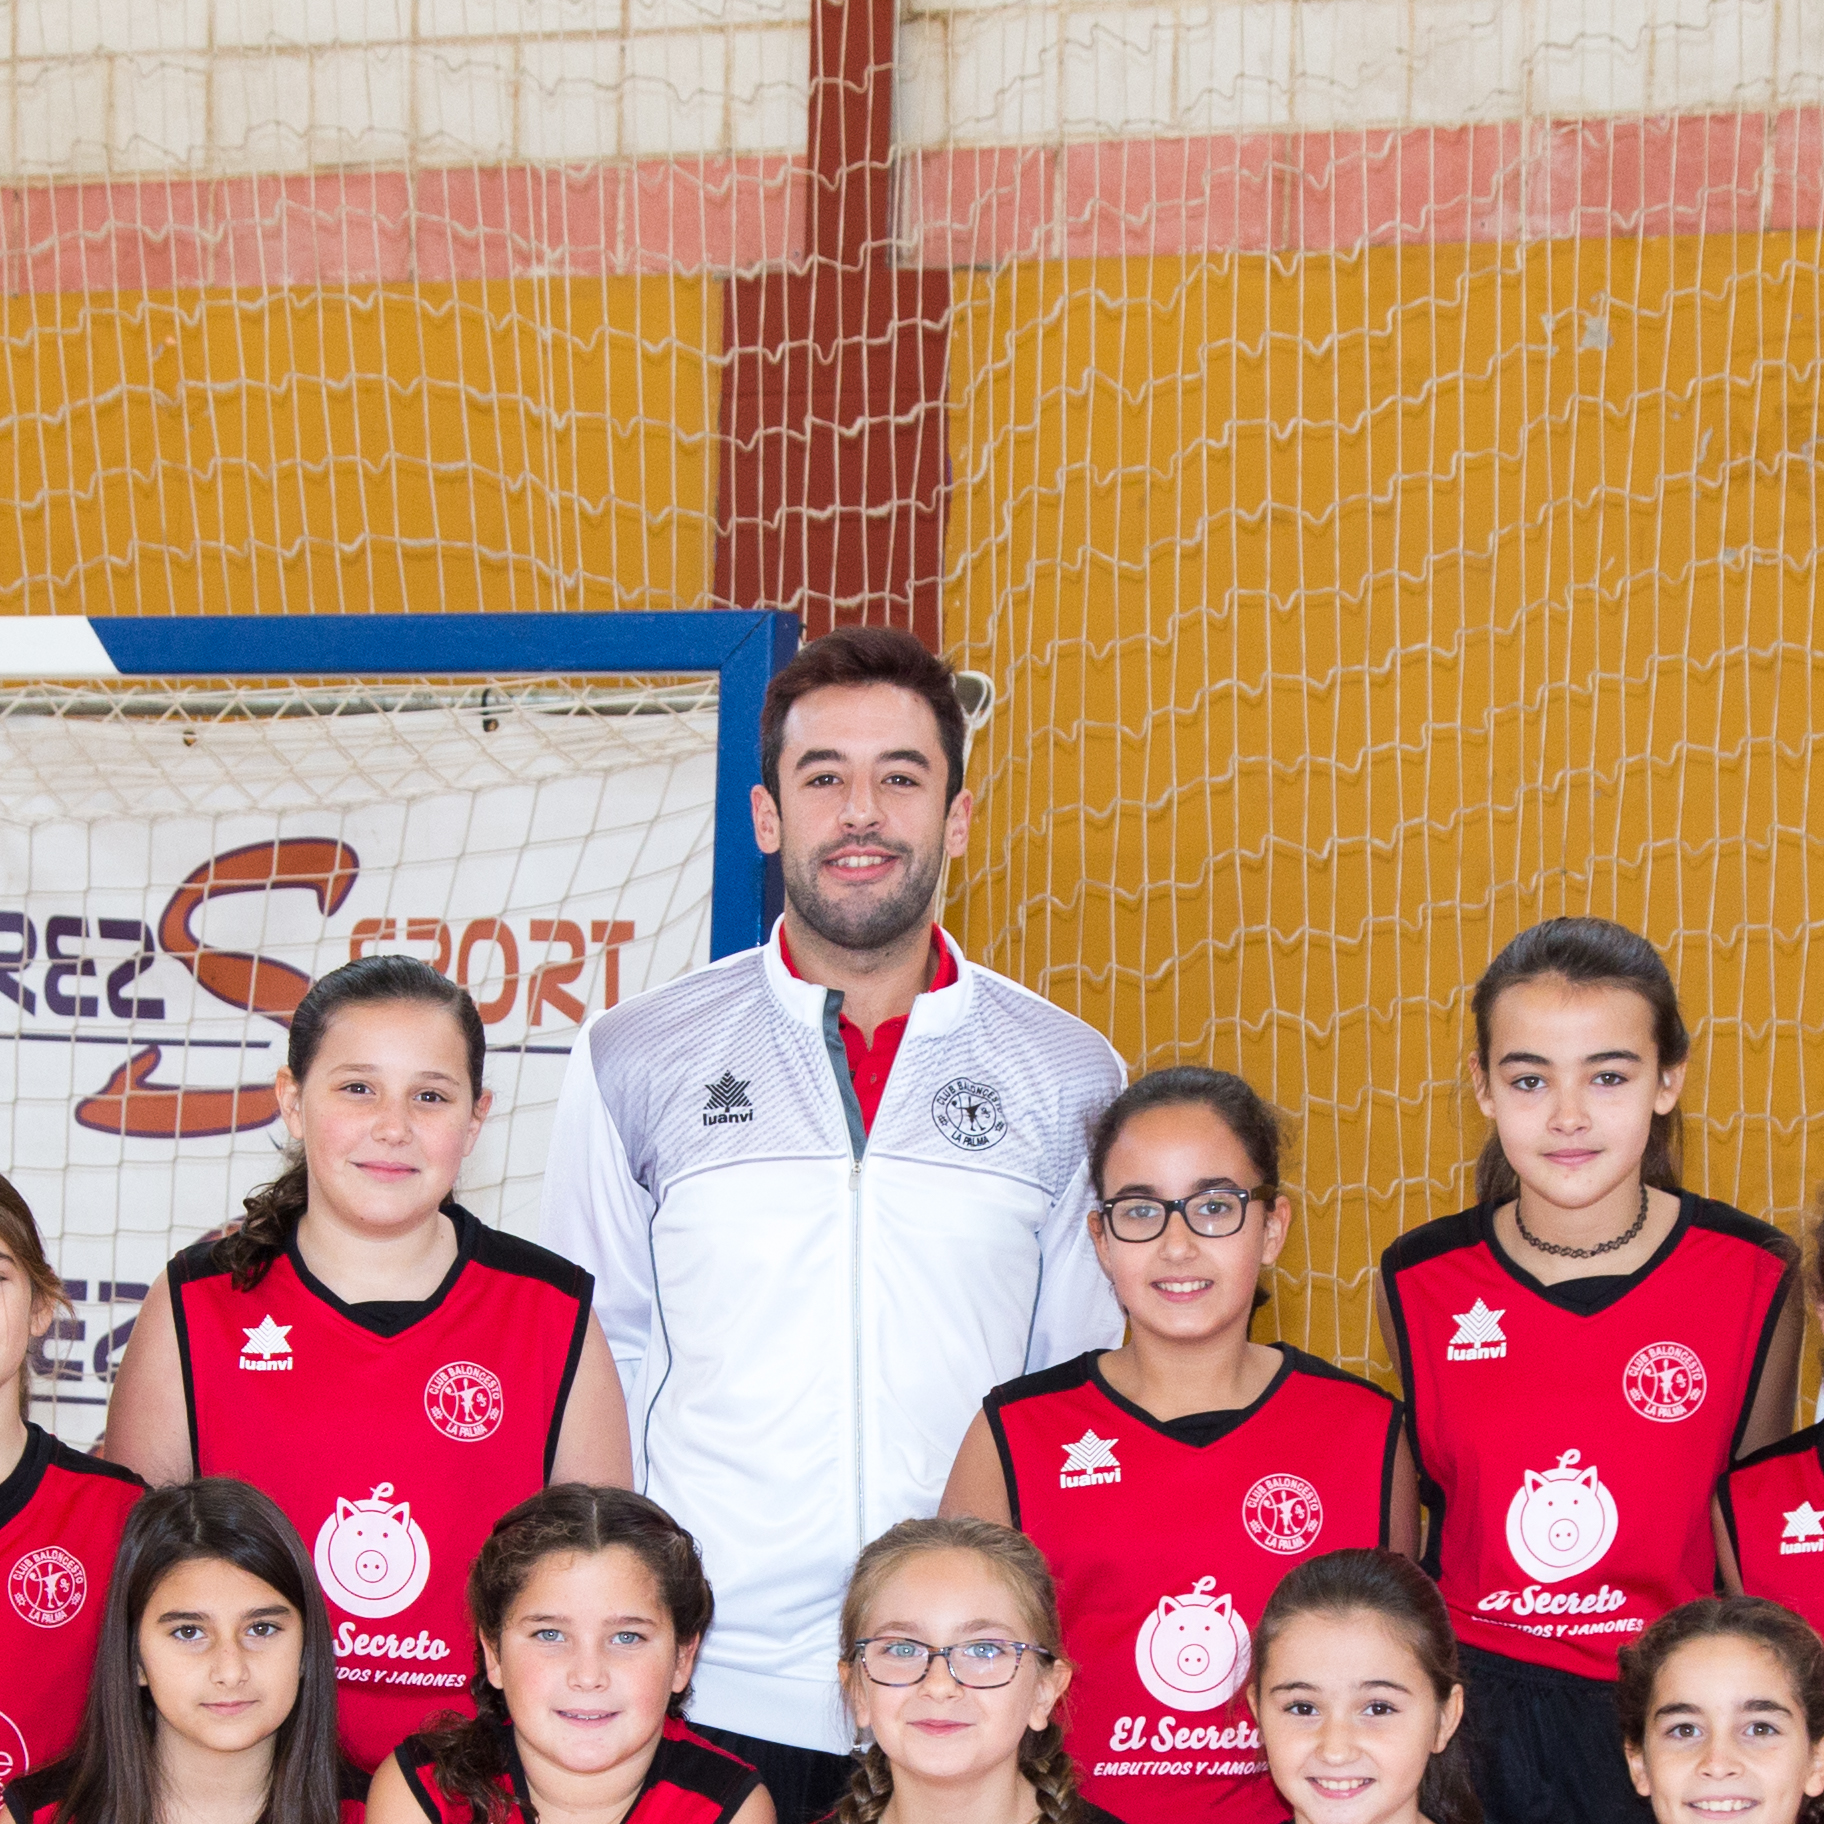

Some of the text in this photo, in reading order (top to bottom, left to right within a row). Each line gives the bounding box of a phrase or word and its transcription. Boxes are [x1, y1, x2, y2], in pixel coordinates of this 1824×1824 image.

[936, 1085, 956, 1106] CLUB
[702, 1109, 754, 1126] luanvi
[951, 1130, 990, 1147] LA PALMA
[1447, 1342, 1507, 1361] luanvi
[239, 1356, 293, 1371] luanvi
[1628, 1345, 1703, 1381] CLUB BALONCESTO
[428, 1365, 501, 1400] CLUB BALONCESTO
[1644, 1403, 1688, 1418] LA PALMA
[445, 1422, 488, 1438] LA PALMA
[1060, 1467, 1122, 1489] luanvi
[1246, 1477, 1320, 1511] CLUB BALONCESTO
[1264, 1535, 1306, 1550] LA PALMA
[1780, 1538, 1824, 1555] luanvi
[12, 1549, 84, 1585] CLUB BALONCESTO
[1512, 1584, 1627, 1616] Secreto
[28, 1608, 69, 1624] LA PALMA
[1556, 1624, 1569, 1638] Y
[1567, 1618, 1644, 1636] JAMONES
[332, 1621, 451, 1661] Secreto
[374, 1670, 388, 1683] Y
[385, 1670, 467, 1688] JAMONES
[1109, 1716, 1147, 1753] El
[1093, 1760, 1192, 1777] EMBUTIDOS
[1194, 1761, 1209, 1776] Y
